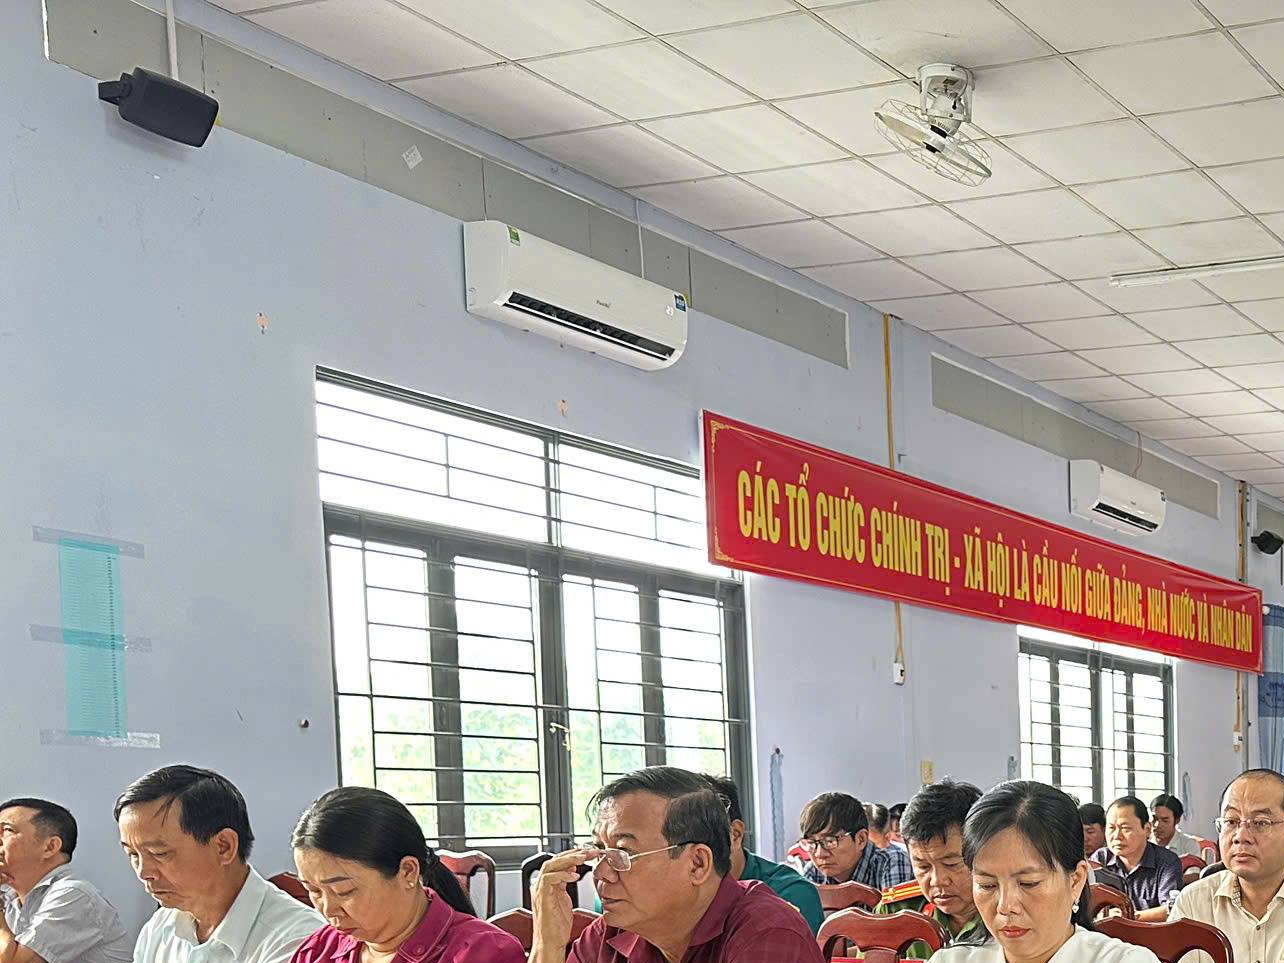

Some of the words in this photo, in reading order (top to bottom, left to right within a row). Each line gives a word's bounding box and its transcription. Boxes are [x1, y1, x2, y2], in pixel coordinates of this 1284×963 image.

[738, 460, 781, 544] CÁC
[785, 462, 811, 551] TỔ
[815, 486, 866, 564] CHỨC
[870, 501, 922, 576] CHÍNH
[925, 523, 950, 596] TRỊ
[963, 526, 984, 591] XÃ
[987, 532, 1010, 608] HỘI
[1013, 539, 1030, 602] LÀ
[1033, 539, 1058, 609] CẦU
[1061, 548, 1082, 614] NỐI
[1085, 563, 1111, 621] GIỮA
[1113, 564, 1145, 635] ĐẢNG,
[1147, 581, 1168, 635] NHÀ
[1169, 588, 1195, 640] NƯỚC
[1197, 592, 1209, 643] VÀ
[1210, 600, 1234, 649] NHÂN
[1235, 604, 1253, 653] DÂN
